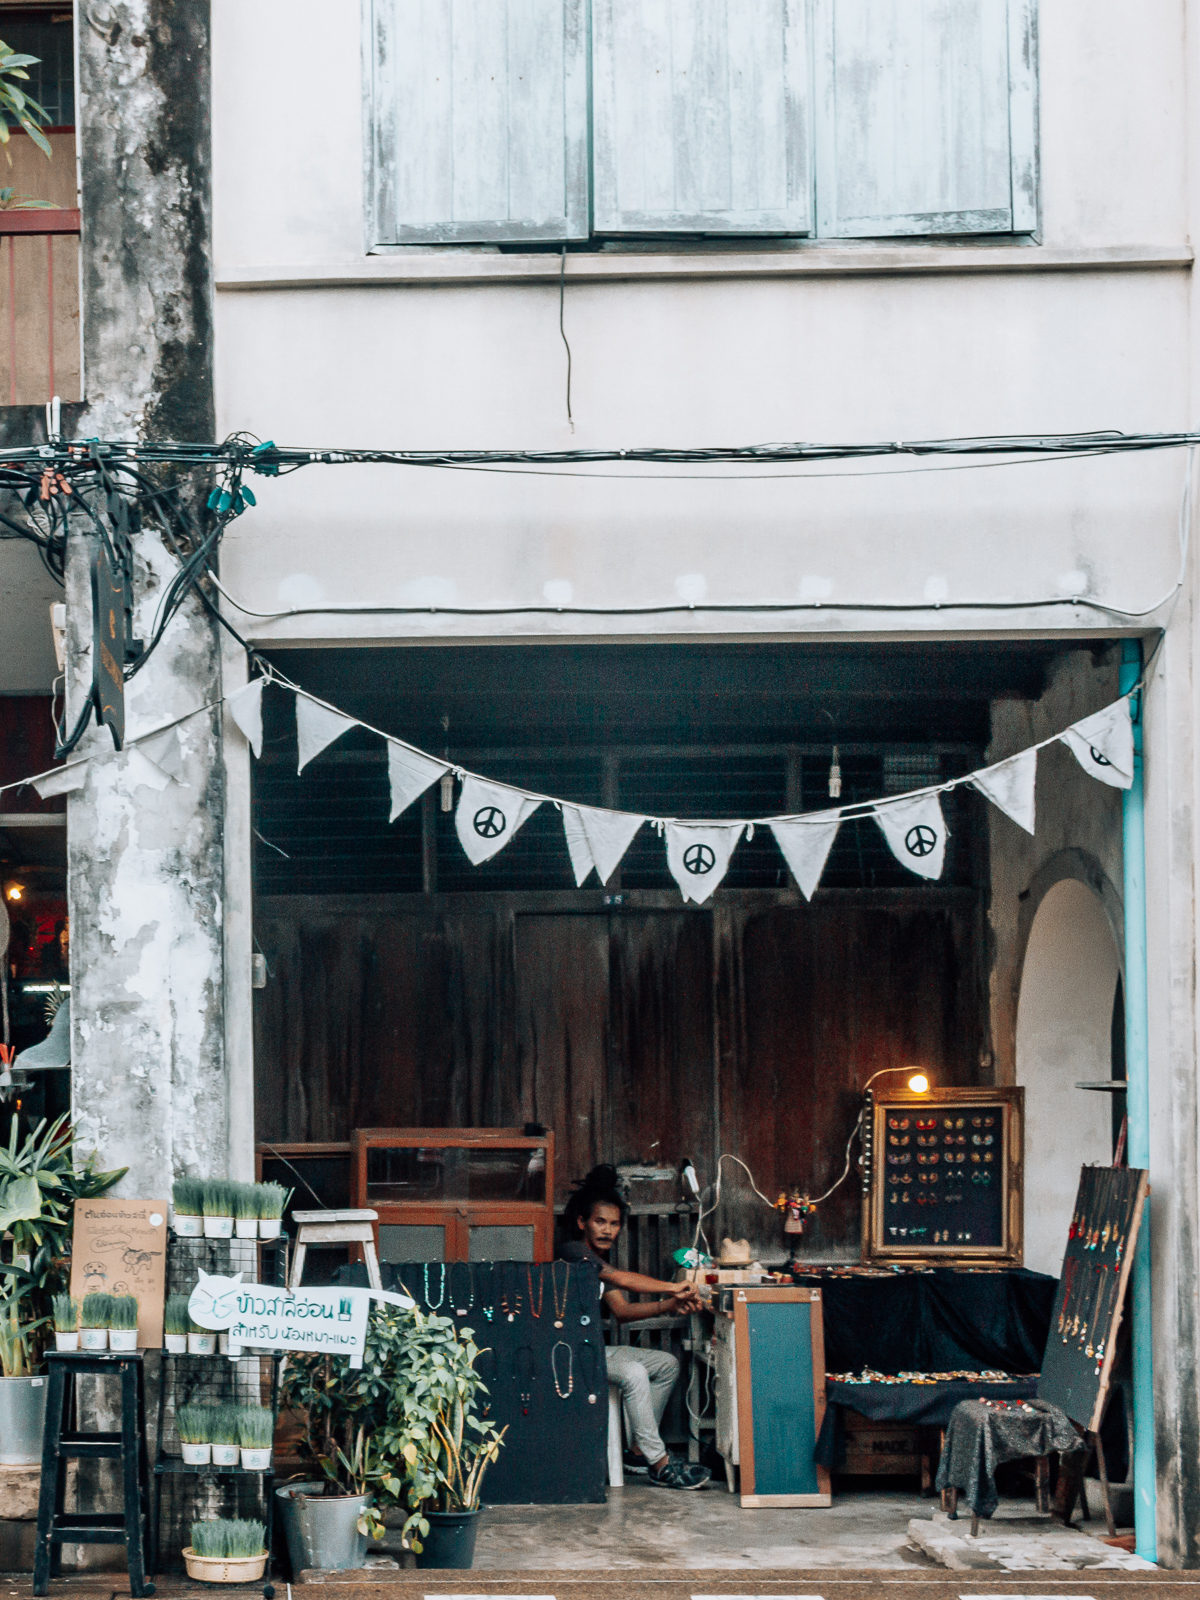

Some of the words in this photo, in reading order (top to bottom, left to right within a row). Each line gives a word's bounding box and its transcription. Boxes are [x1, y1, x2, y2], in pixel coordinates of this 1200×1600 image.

[236, 1290, 333, 1319] ข้าวสาลีอ่อน
[232, 1321, 279, 1340] สำหรับ
[281, 1326, 358, 1345] น้องหมา-แมว
